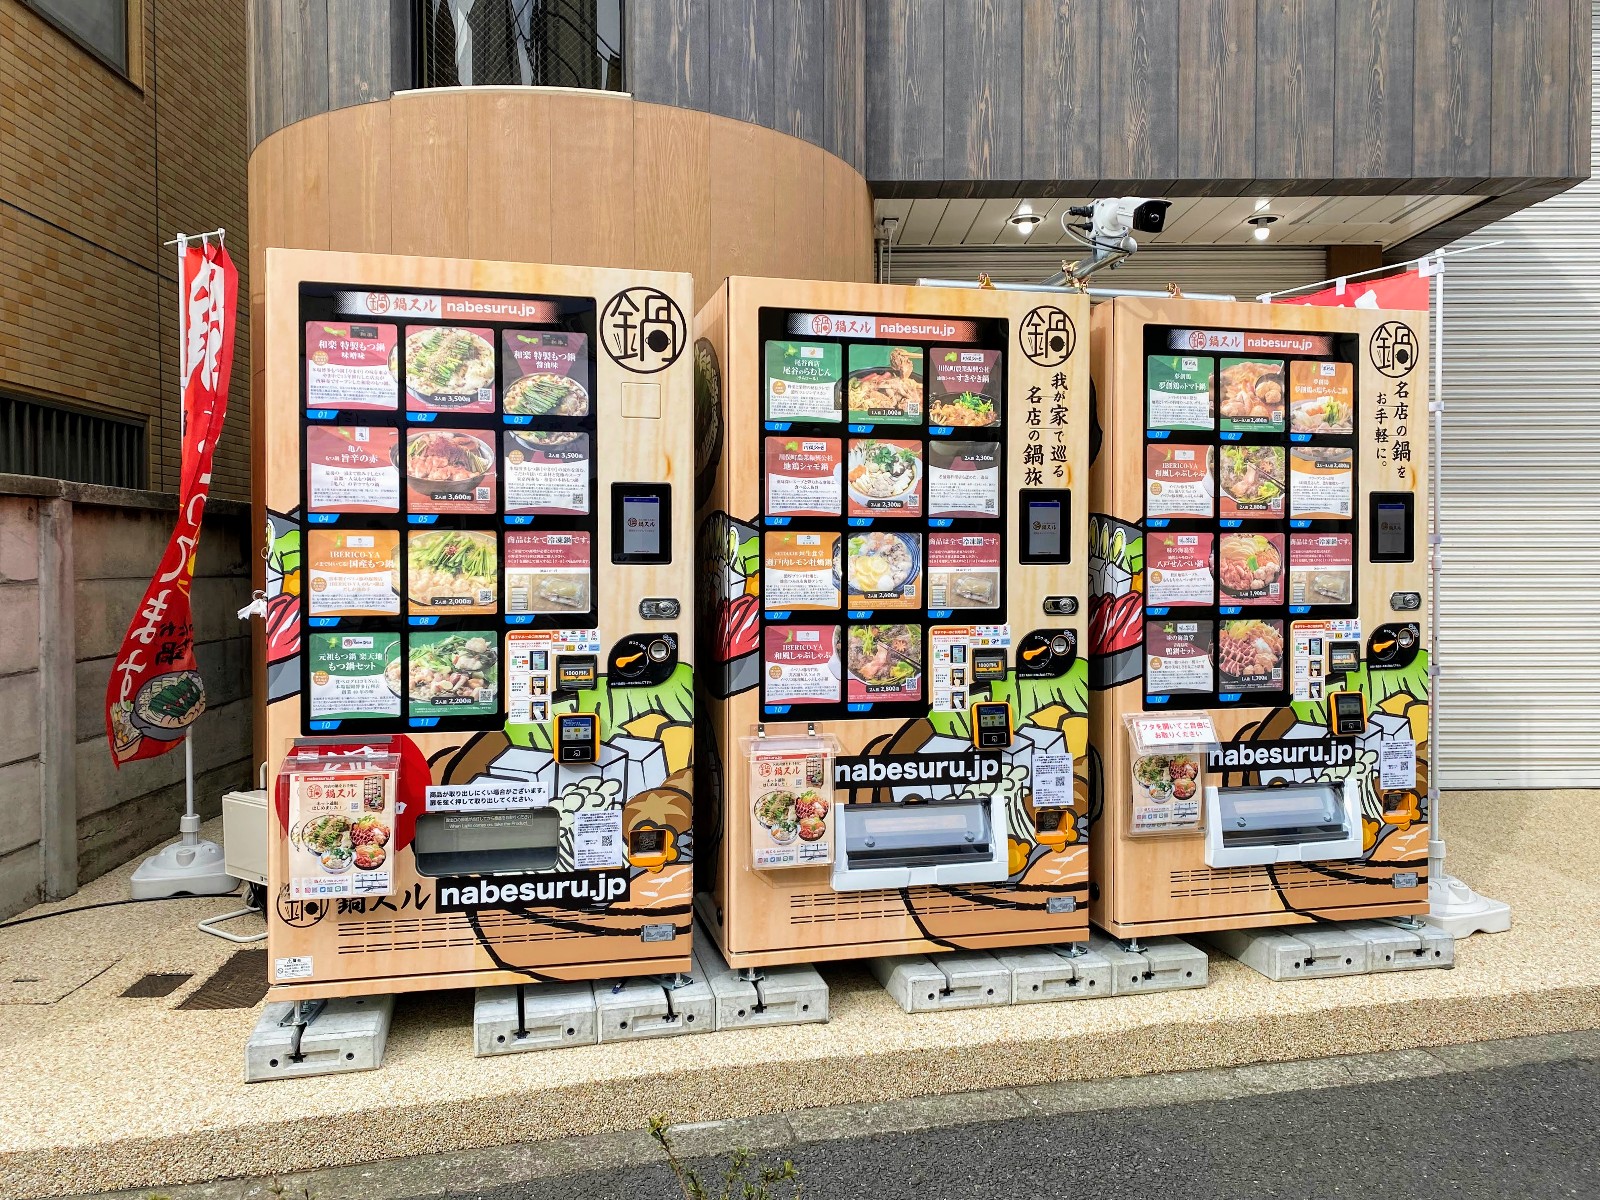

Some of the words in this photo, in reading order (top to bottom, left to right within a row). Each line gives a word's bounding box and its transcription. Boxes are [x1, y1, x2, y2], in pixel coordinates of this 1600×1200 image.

[392, 296, 437, 313] 鍋スル
[447, 302, 536, 317] nabesuru.jp
[834, 320, 872, 334] 鍋スル
[880, 323, 955, 336] nabesuru.jp
[1208, 335, 1240, 348] 鍋スル
[1248, 337, 1313, 351] nabesuru.jp
[1049, 371, 1069, 478] 我が家で巡る
[1374, 392, 1389, 467] お手軽に。
[1391, 380, 1411, 479] 名店の鍋を
[1022, 385, 1045, 487] 名店の鍋旅
[1227, 432, 1236, 440] 02
[1155, 469, 1206, 478] 和風しゃぶしゃぶ
[514, 516, 524, 524] 06
[857, 518, 865, 526] 05
[937, 519, 946, 527] 06
[856, 611, 865, 619] 08
[320, 618, 330, 626] 07
[419, 617, 429, 625] 08
[774, 651, 831, 660] 和風しゃぶしゃぶ
[329, 662, 376, 671] もつ鍋セット
[321, 721, 331, 729] 10
[420, 718, 429, 726] 11
[1141, 721, 1211, 731] フタを開いてご自由に
[1155, 731, 1203, 739] お取りください
[1209, 740, 1353, 767] nabesuru.jp
[836, 755, 998, 782] nabesuru.jp
[440, 873, 627, 906] nabesuru.jp
